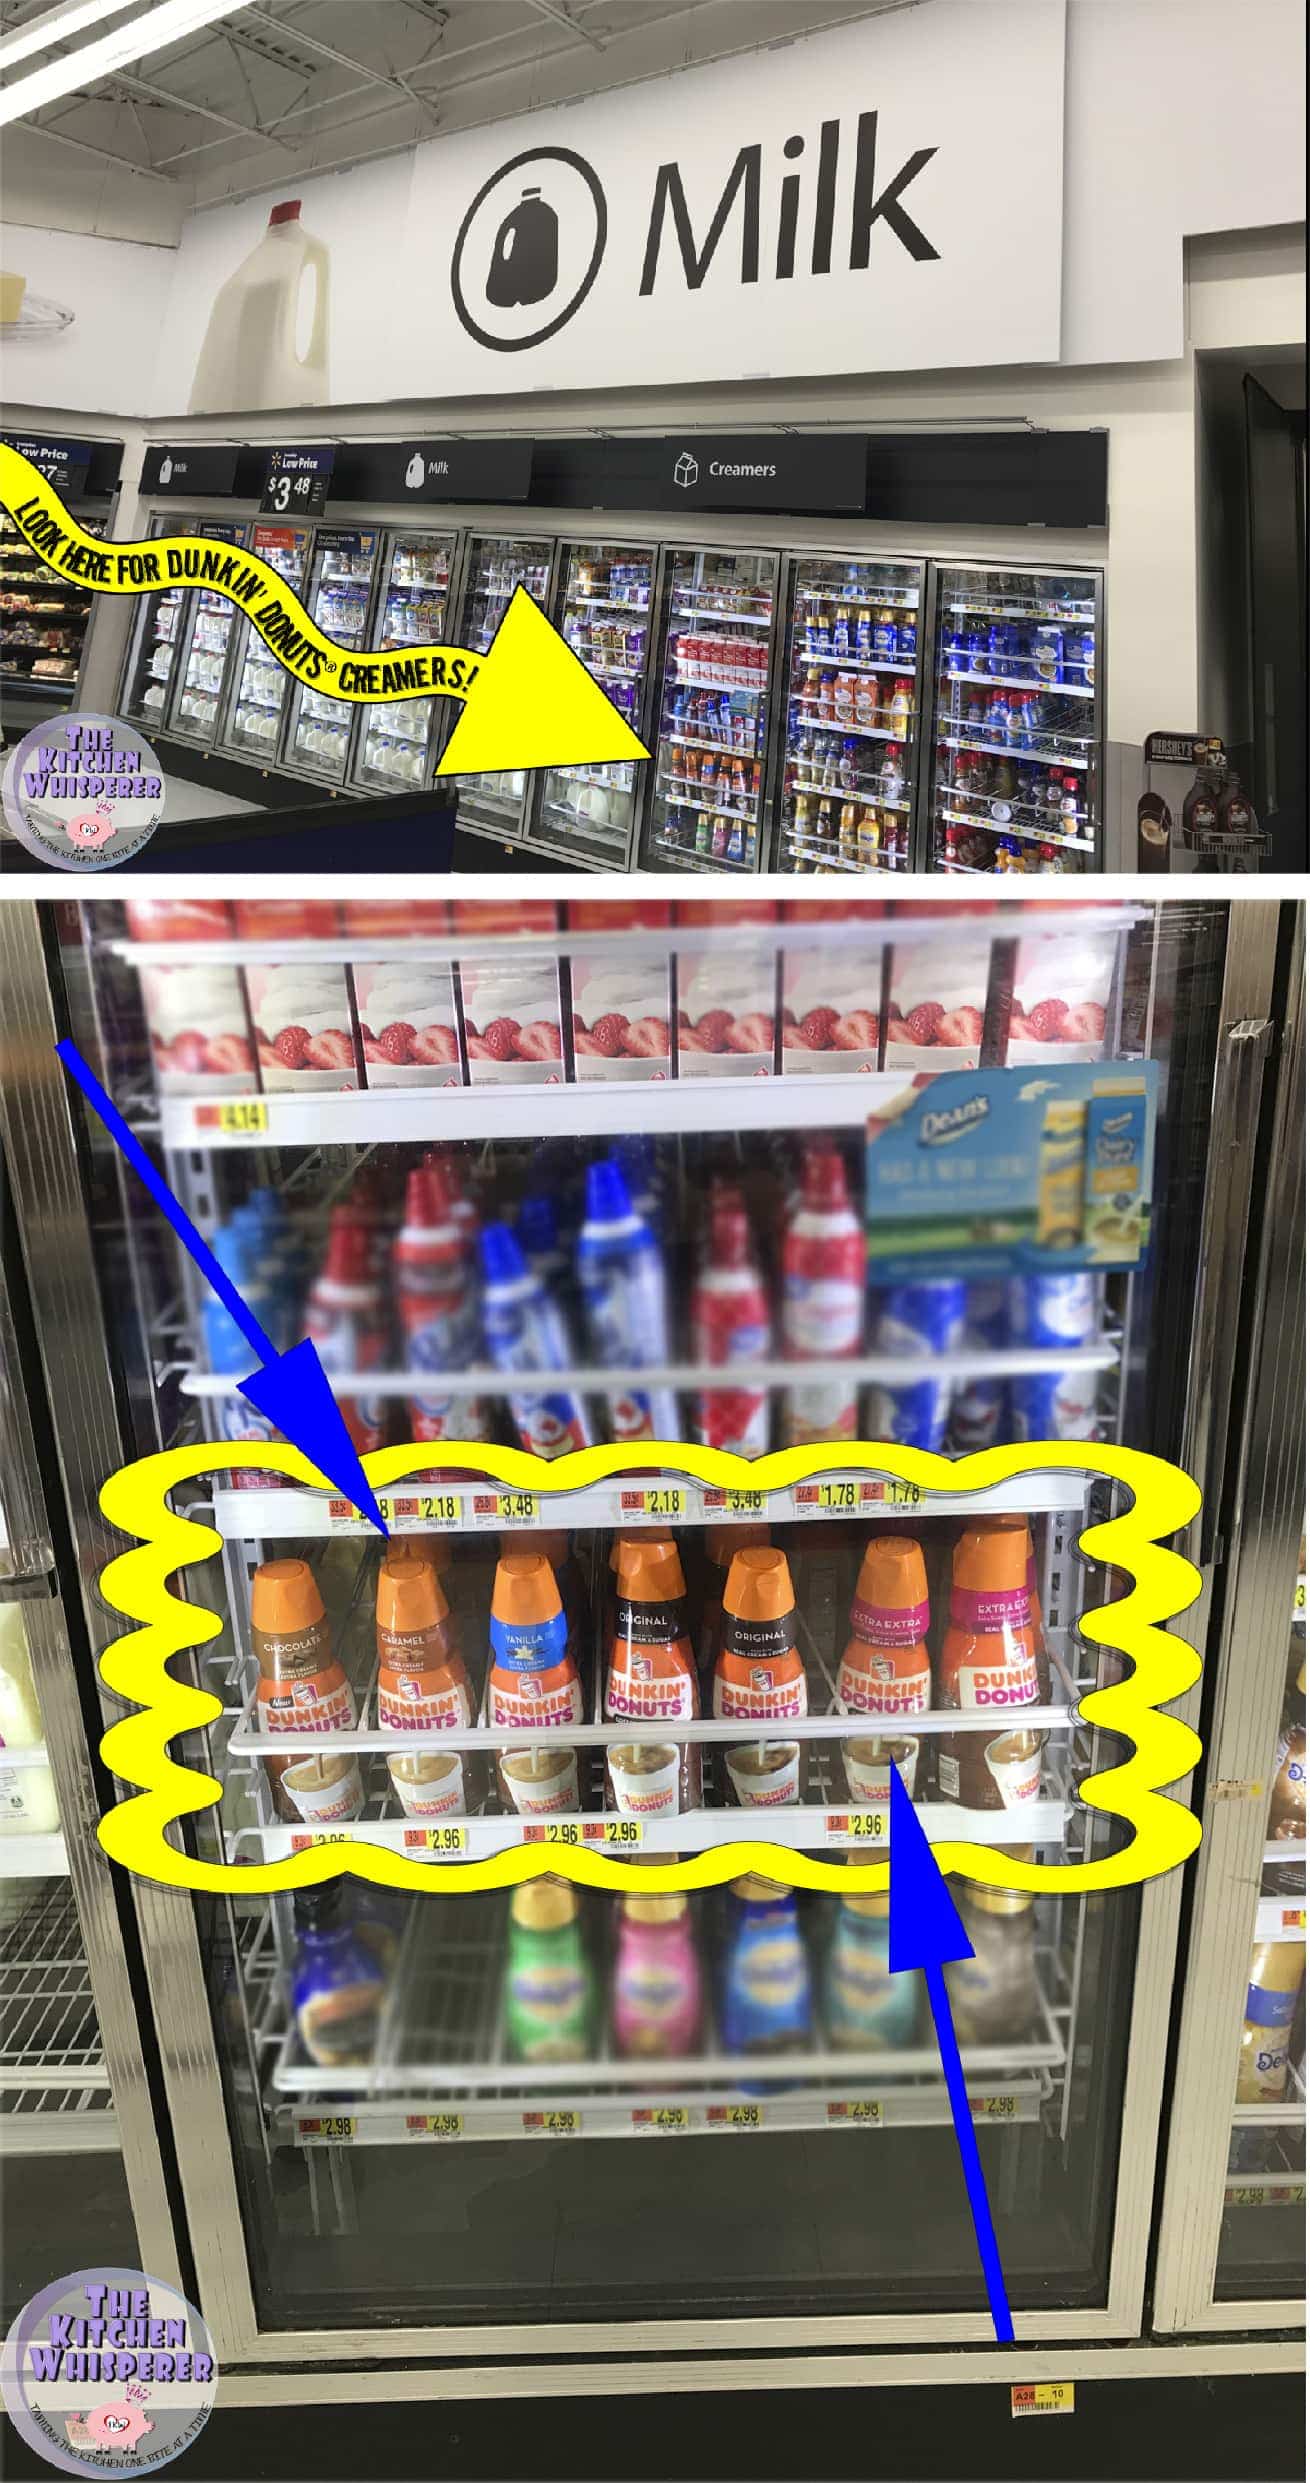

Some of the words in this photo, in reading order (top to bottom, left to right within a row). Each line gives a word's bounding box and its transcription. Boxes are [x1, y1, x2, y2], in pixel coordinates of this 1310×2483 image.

[638, 110, 942, 297] Milk
[40, 448, 69, 460] Price
[283, 455, 298, 469] Low
[299, 457, 319, 469] Price
[428, 461, 449, 474] Milk
[709, 461, 777, 477] Creamers
[505, 1633, 544, 1645] VANILLA
[734, 1629, 787, 1643] ORIGINAL
[610, 1680, 686, 1700] DUNKIN'
[721, 1683, 801, 1708] DUNKIN'
[842, 1670, 928, 1698] DUNKIN'
[266, 1689, 348, 1726] DUNKIN'
[379, 1694, 459, 1717] DUNKIN'
[494, 1688, 574, 1716] DUNKIN'
[607, 1690, 683, 1718] DONUTS
[720, 1700, 800, 1719] DONUTS
[840, 1686, 925, 1714] DONUTS
[379, 1707, 459, 1730] DONUTS
[494, 1705, 575, 1728] DONUTS
[1052, 2389, 1064, 2399] 10
